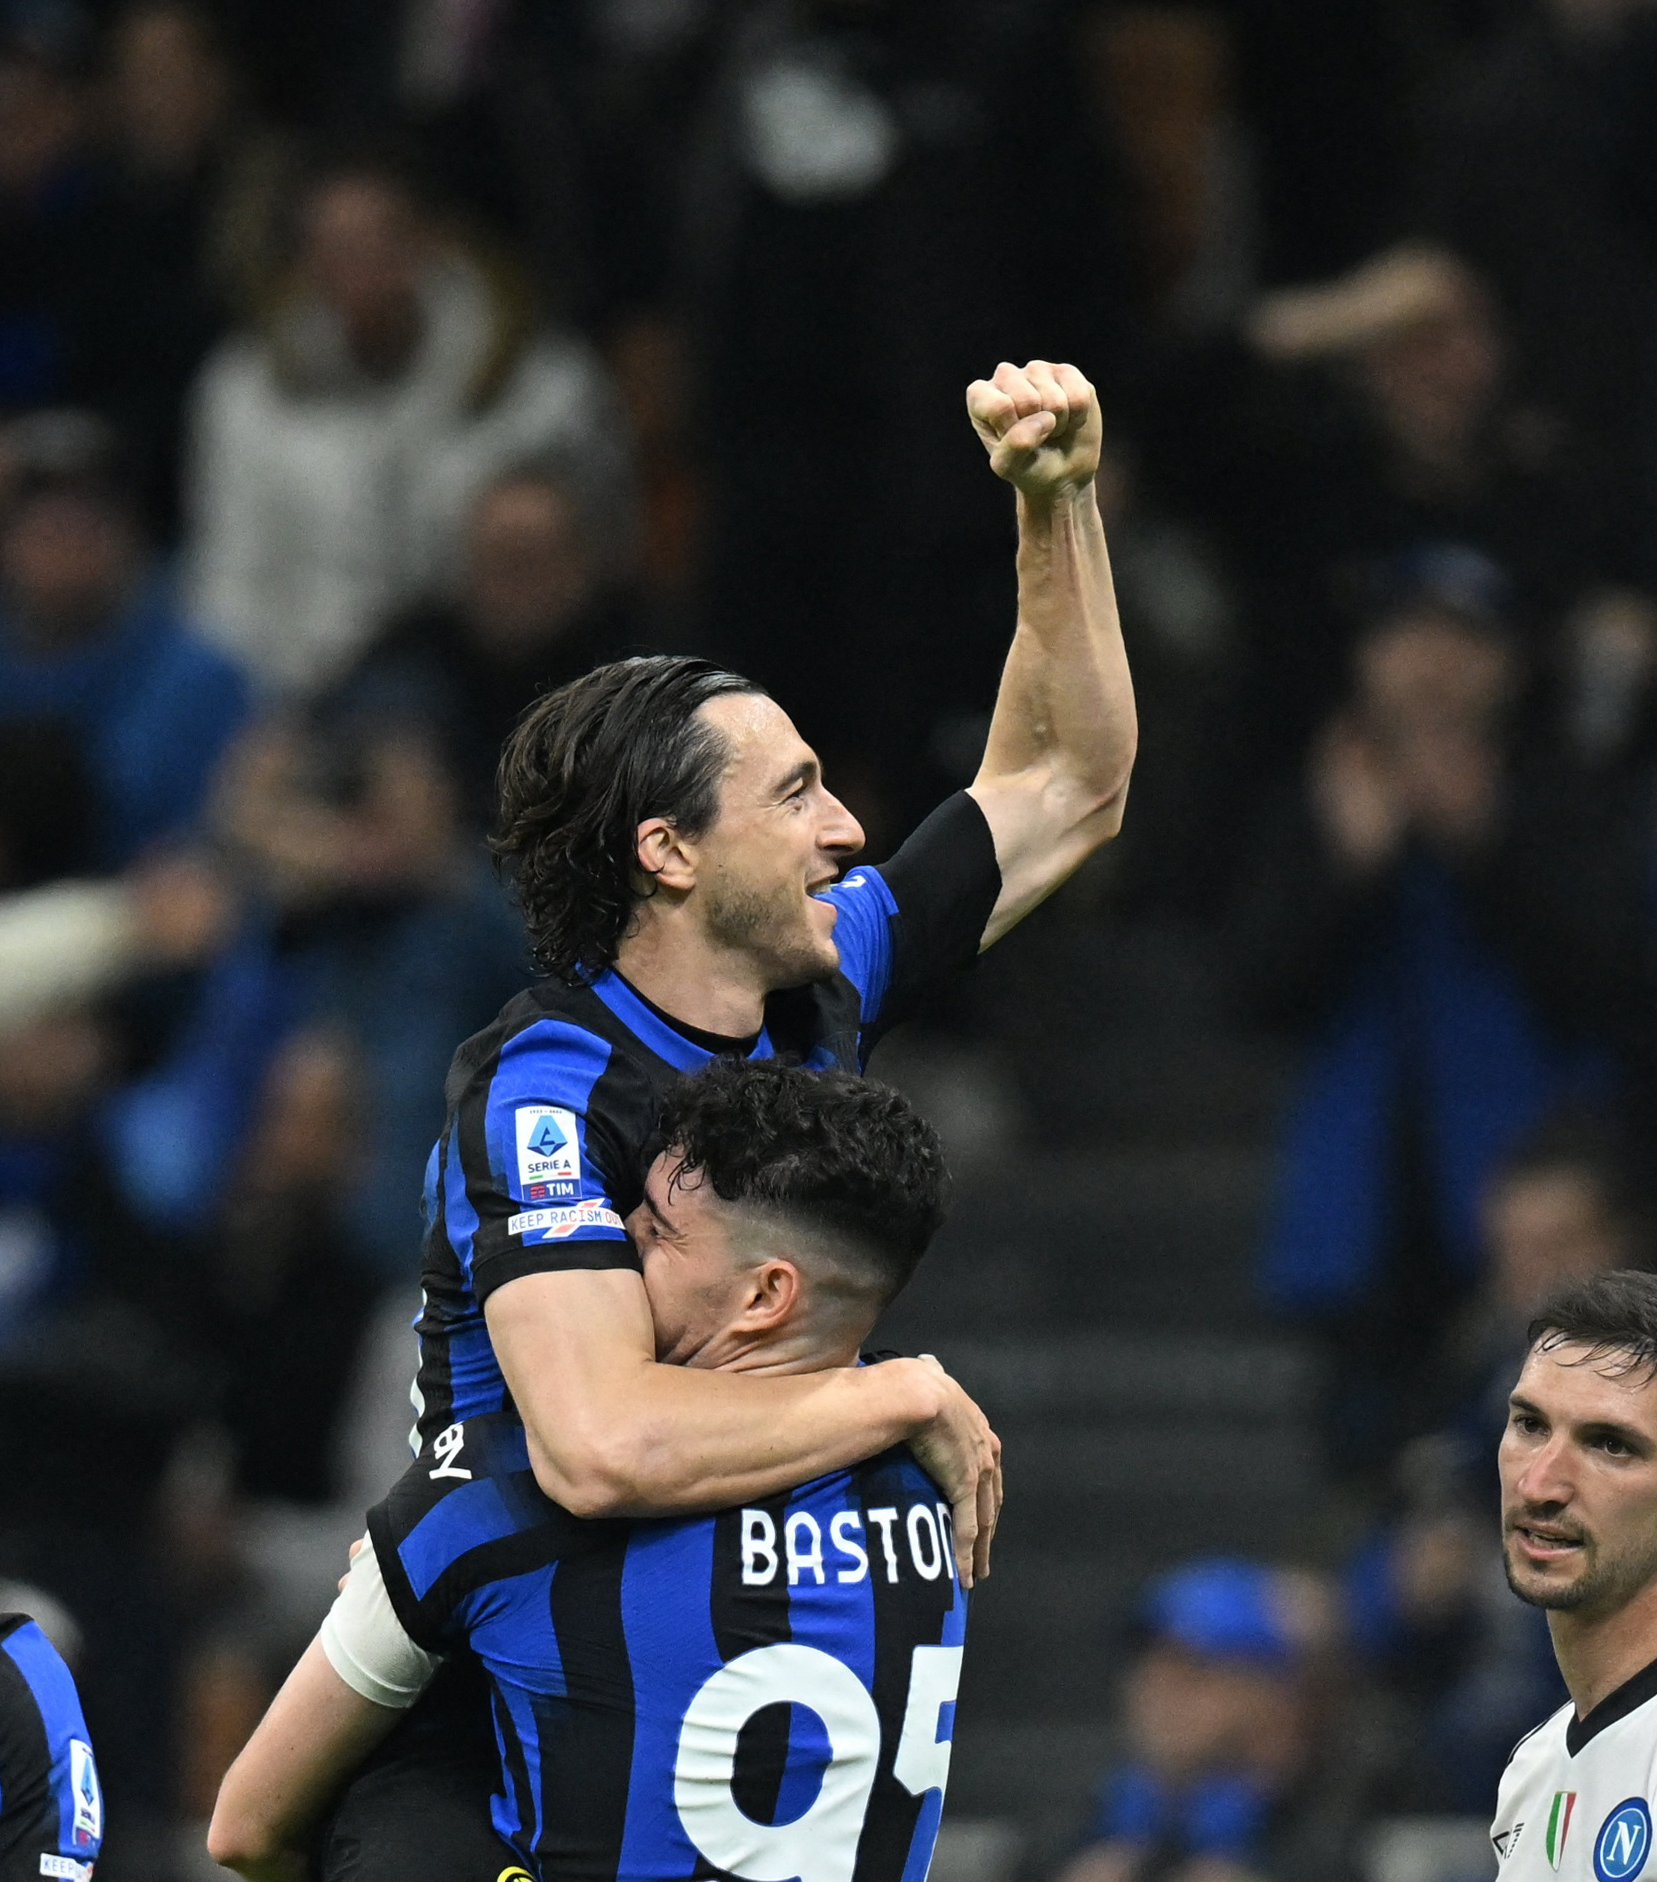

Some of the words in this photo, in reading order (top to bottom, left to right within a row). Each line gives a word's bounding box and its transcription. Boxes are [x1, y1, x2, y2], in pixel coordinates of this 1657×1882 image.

[527, 1159, 560, 1174] SERIE
[563, 1159, 572, 1170] A
[546, 1182, 574, 1197] TIM
[510, 1212, 545, 1232] KEEP
[550, 1208, 603, 1224] RACISM
